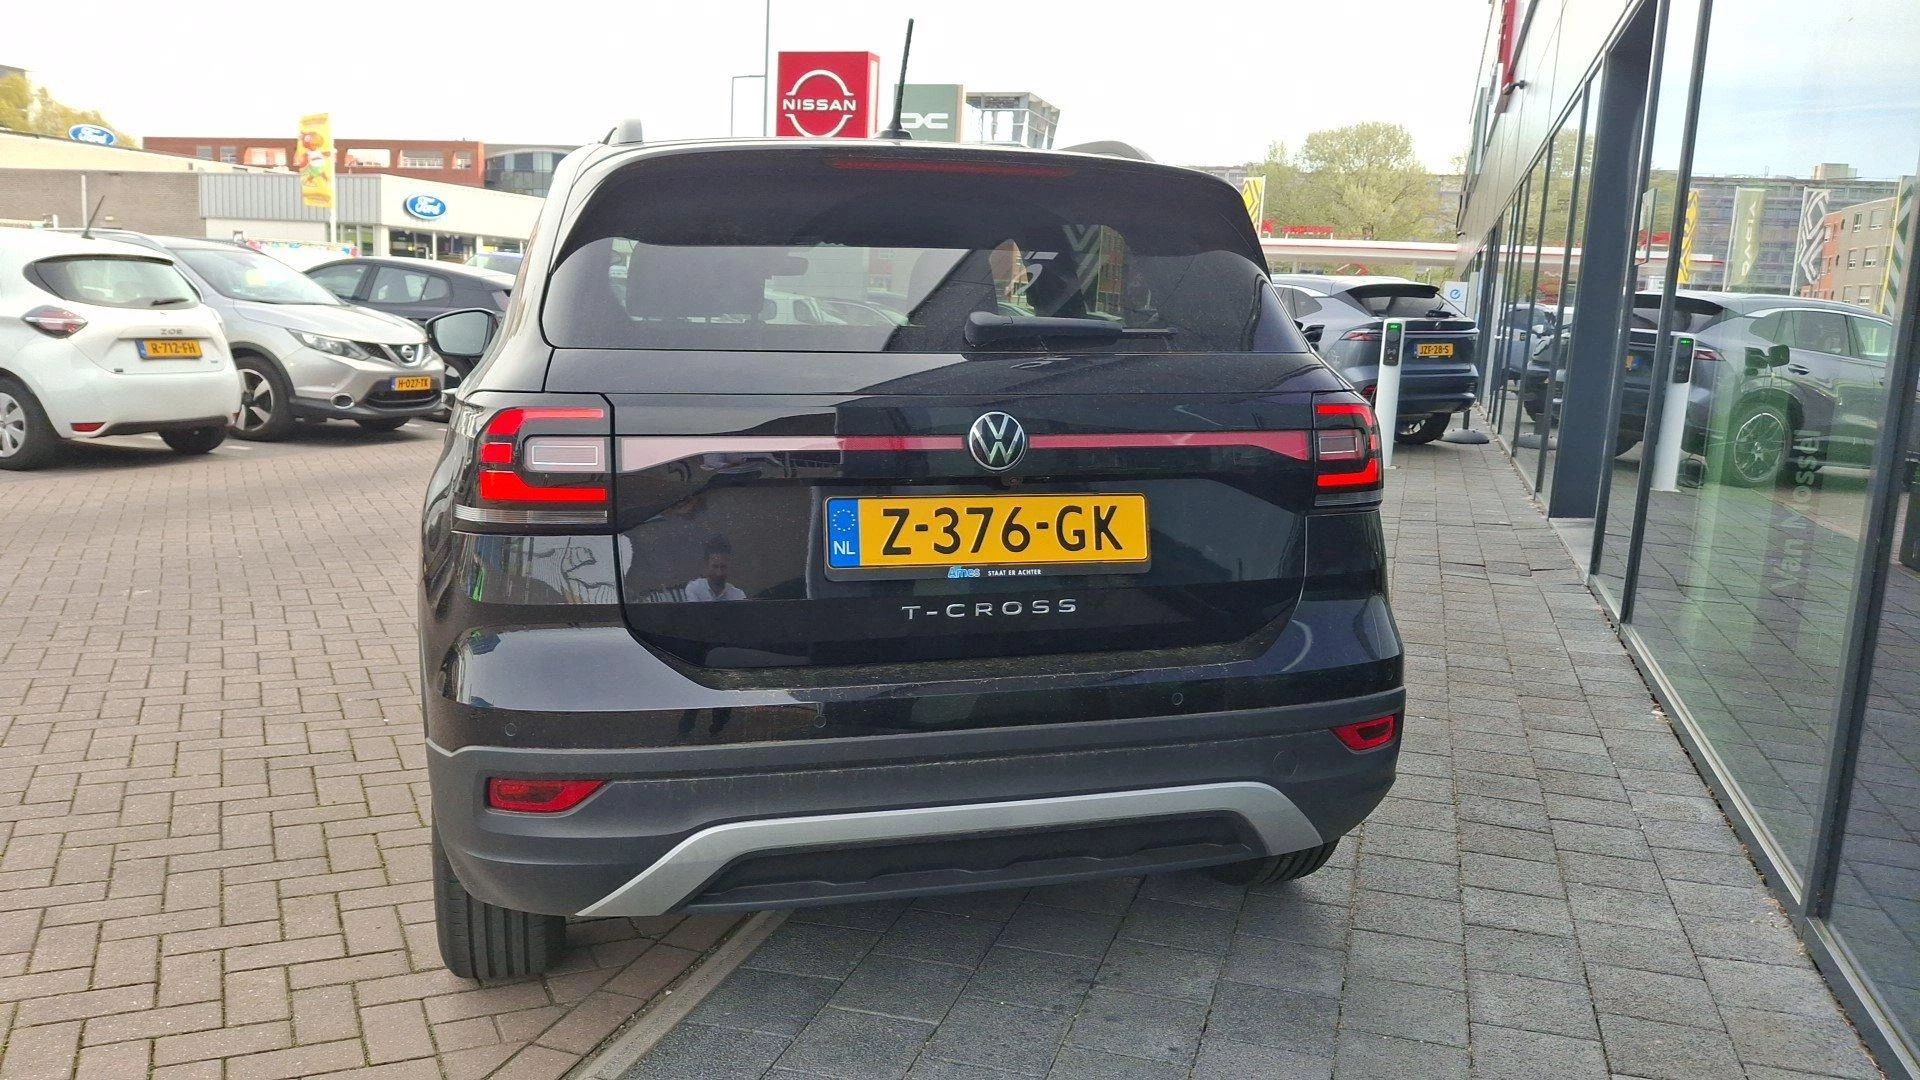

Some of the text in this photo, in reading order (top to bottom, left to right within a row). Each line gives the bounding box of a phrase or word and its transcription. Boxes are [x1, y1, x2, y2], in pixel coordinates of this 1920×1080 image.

[781, 98, 857, 112] NISSAN
[1741, 200, 1757, 277] DACIA
[160, 328, 184, 336] ZOE
[150, 340, 196, 354] R-712-FH
[882, 505, 1123, 556] Z-376-GK
[833, 540, 856, 555] NL
[1017, 568, 1042, 576] ACHTER
[901, 598, 1077, 620] T-CROSS
